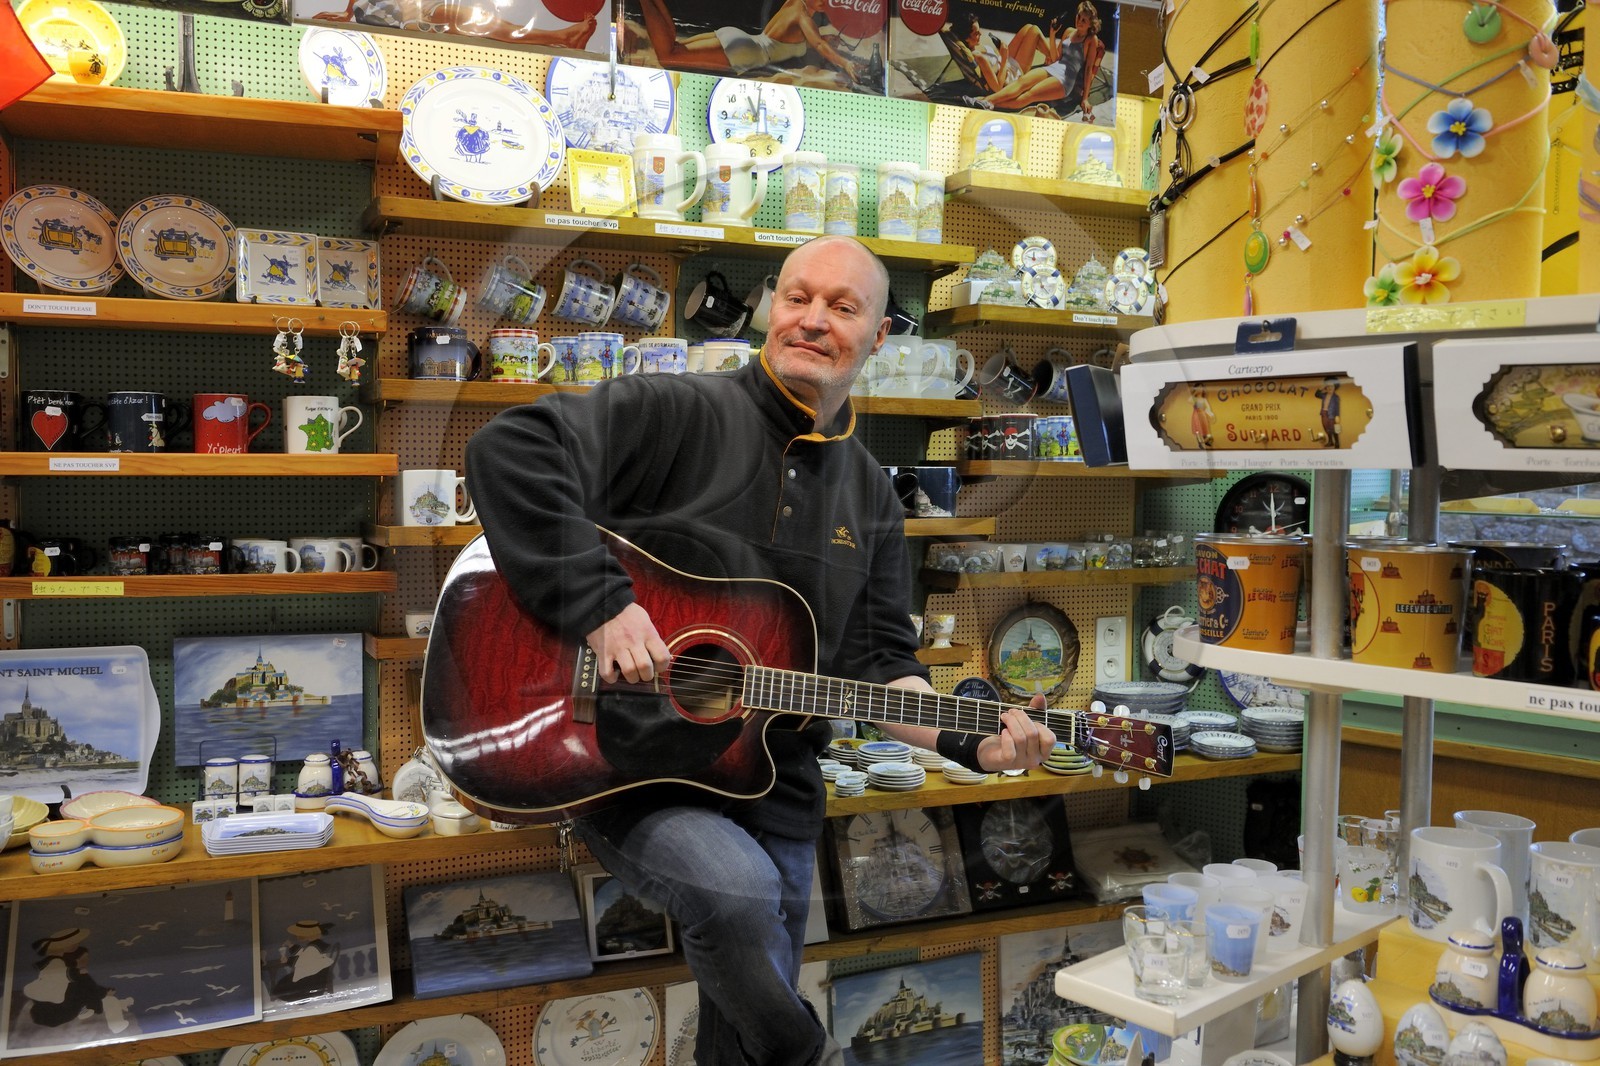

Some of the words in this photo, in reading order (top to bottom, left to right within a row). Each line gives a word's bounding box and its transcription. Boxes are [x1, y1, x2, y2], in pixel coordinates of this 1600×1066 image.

[1005, 1, 1045, 17] refreshing
[557, 218, 571, 226] pas
[572, 219, 600, 227] toucher
[1228, 363, 1274, 376] Cartexpo
[1217, 381, 1309, 402] CHOCOLAT
[1241, 403, 1264, 412] GRAND
[1265, 403, 1281, 411] PRIX
[1269, 483, 1280, 493] 12
[1540, 601, 1557, 673] PARIS
[17, 668, 54, 677] SAINT
[57, 666, 103, 676] MICHEL
[1529, 695, 1545, 705] ne
[1550, 696, 1574, 712] pas
[1156, 734, 1169, 763] Cort
